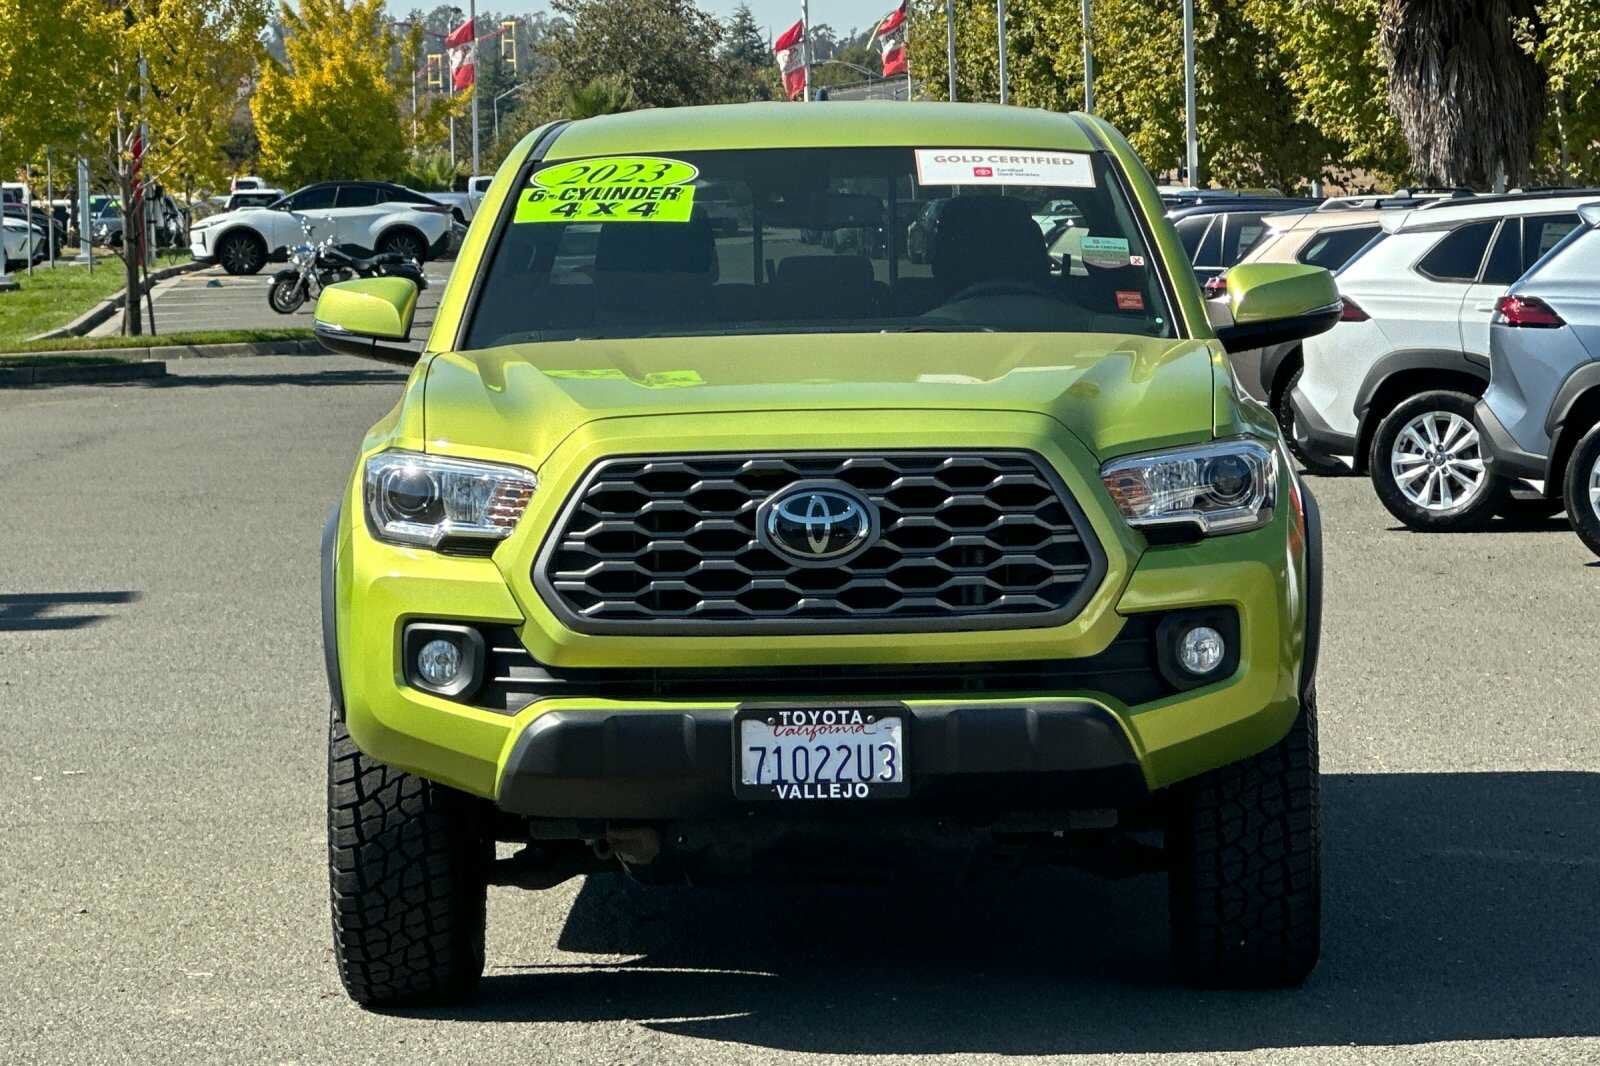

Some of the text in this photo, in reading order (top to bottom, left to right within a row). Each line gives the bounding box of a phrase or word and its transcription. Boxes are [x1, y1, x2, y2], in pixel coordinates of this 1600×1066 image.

[934, 155, 1074, 166] GOLD CERTIFIED
[558, 163, 673, 185] 2023
[528, 186, 682, 202] 6-CYLINDER
[779, 710, 863, 725] TOYOTA
[773, 724, 876, 742] California
[749, 744, 896, 784] 71022U3
[776, 784, 869, 799] VALLEJO
